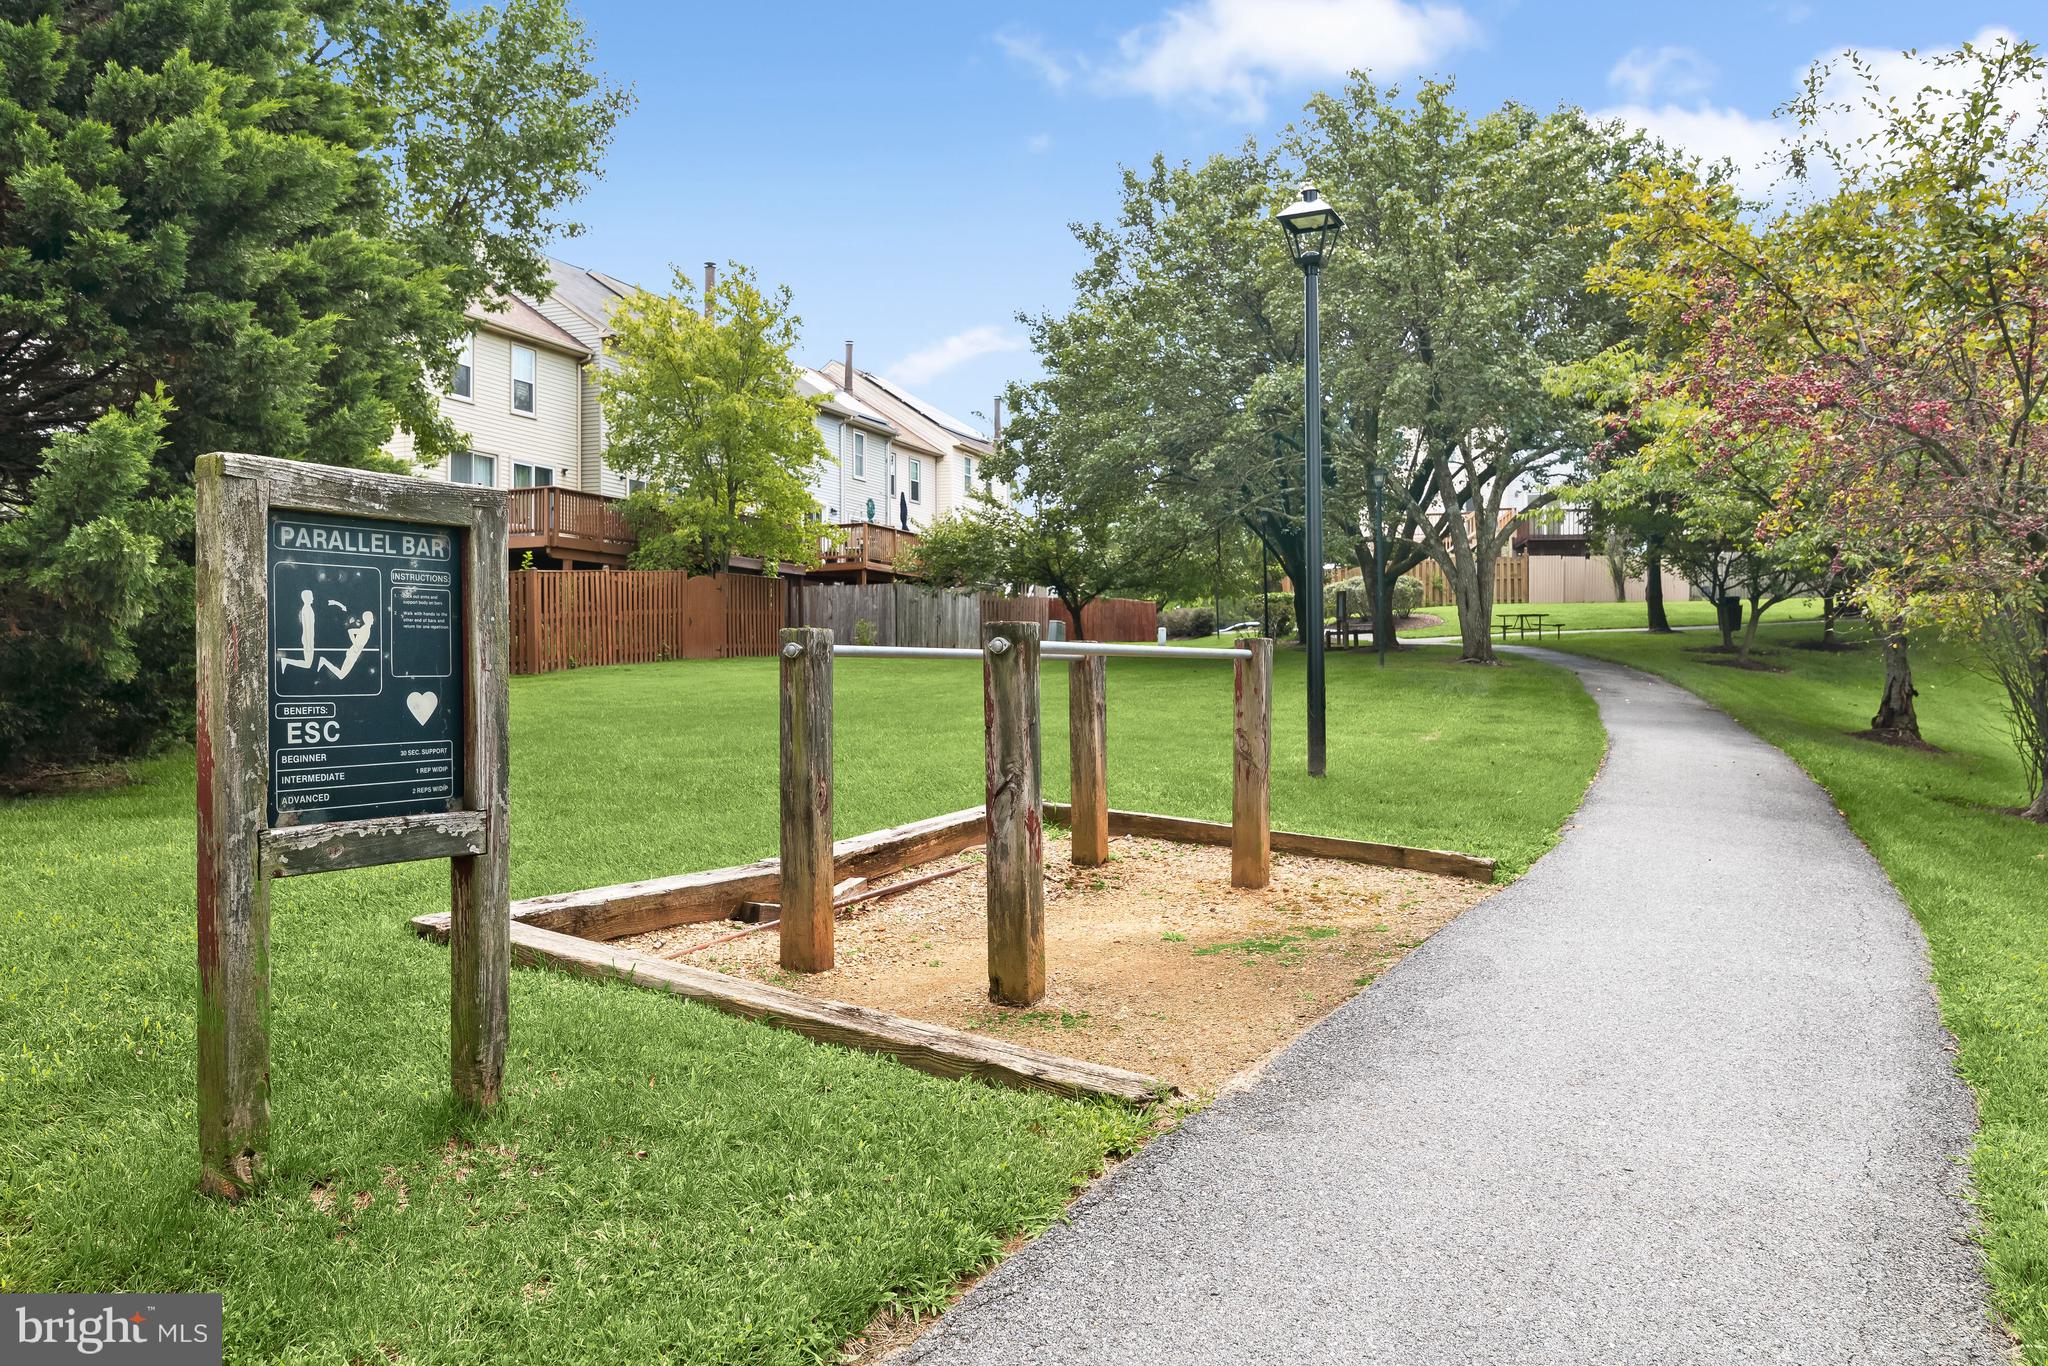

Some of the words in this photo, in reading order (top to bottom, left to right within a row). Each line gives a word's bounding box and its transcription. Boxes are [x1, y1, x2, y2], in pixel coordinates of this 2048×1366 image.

[280, 526, 396, 554] PARALLEL
[402, 536, 445, 558] BAR
[283, 706, 328, 716] BENEFITS:
[287, 720, 341, 744] ESC
[421, 747, 448, 755] SUPPORT
[281, 753, 327, 764] BEGINNER
[281, 772, 345, 784] INTERMEDIATE
[416, 786, 432, 794] REPS
[281, 793, 330, 805] ADVANCED
